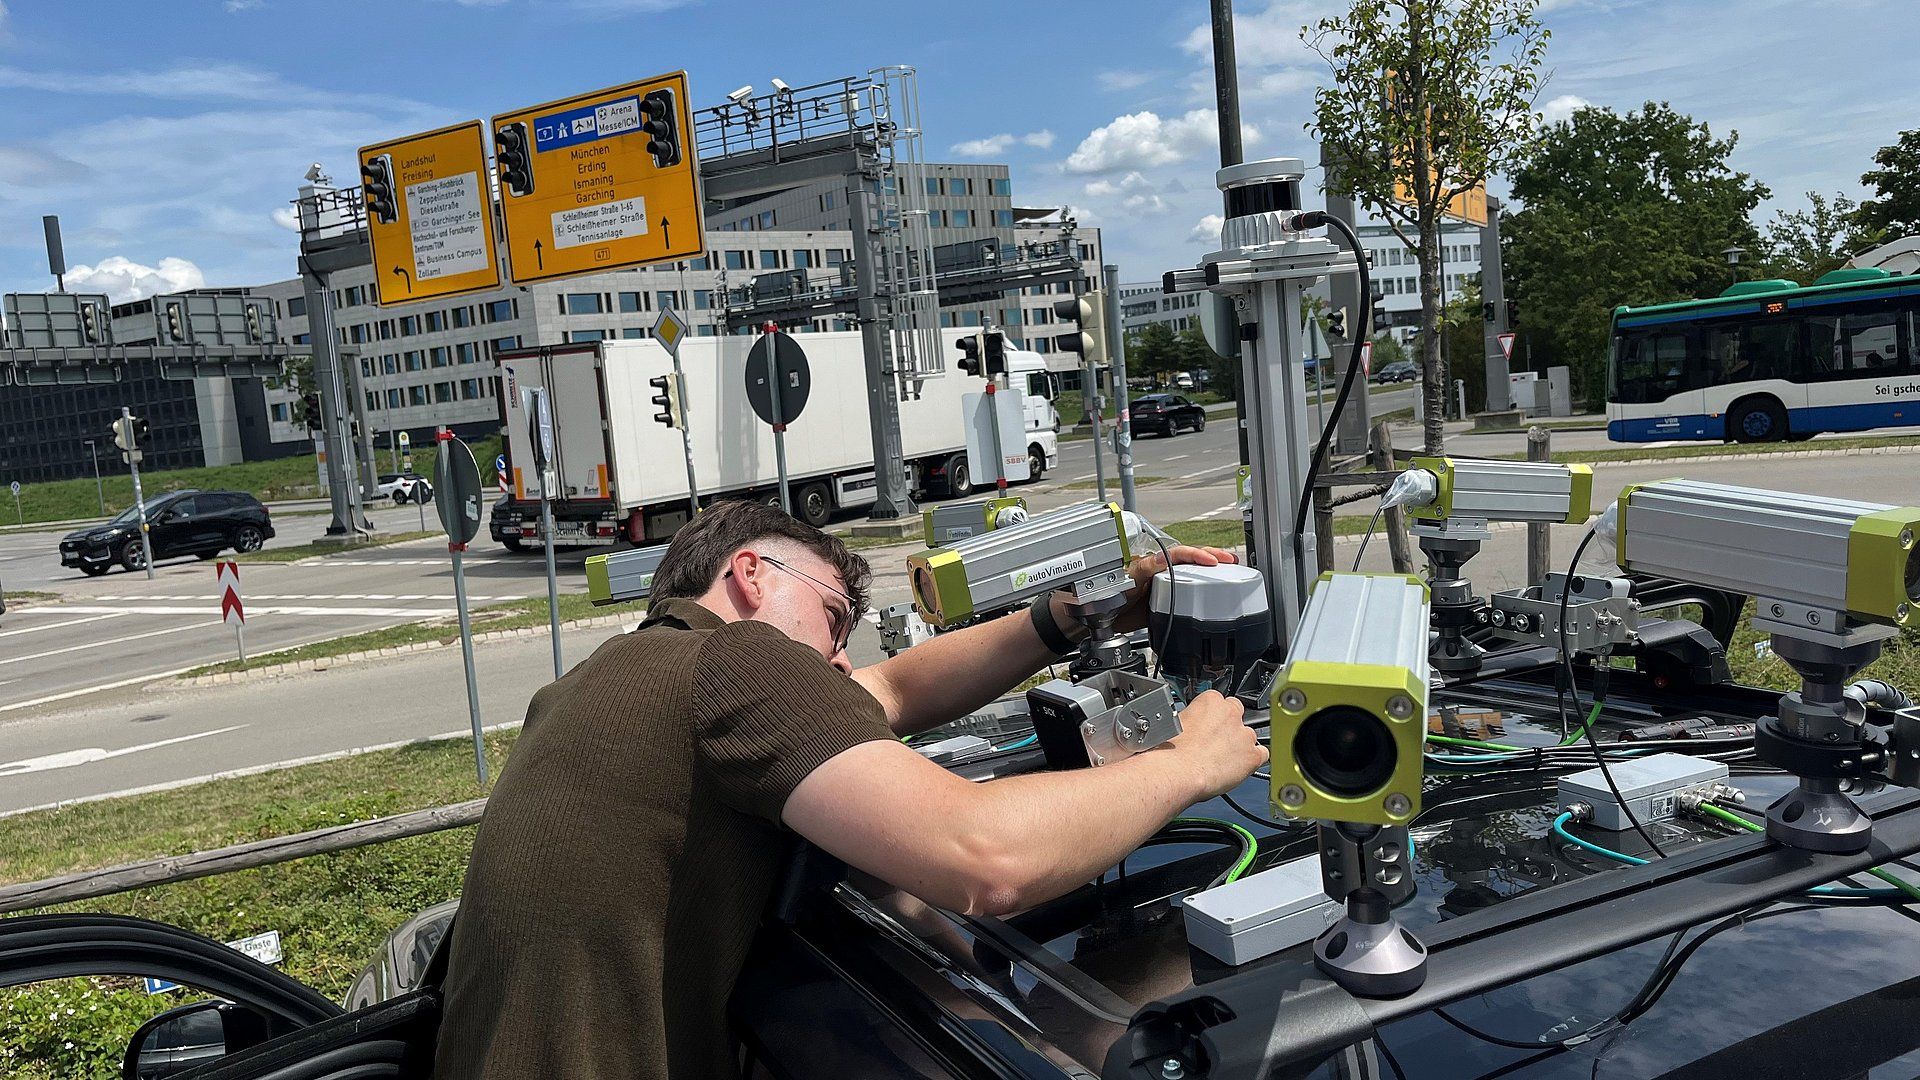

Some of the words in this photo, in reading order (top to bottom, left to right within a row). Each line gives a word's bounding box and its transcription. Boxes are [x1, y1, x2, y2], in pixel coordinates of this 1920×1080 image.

[610, 105, 632, 116] Arena
[587, 120, 593, 128] M
[599, 117, 638, 132] Messe/ICM
[571, 144, 610, 161] München
[401, 154, 436, 170] Landshut
[578, 161, 607, 174] Erding
[402, 168, 434, 182] Freising
[574, 174, 614, 190] Ismaning
[576, 188, 615, 204] Garching
[420, 201, 459, 215] Dieselstraße
[432, 213, 465, 228] Garchinger
[468, 210, 480, 220] See
[567, 218, 616, 234] Schleißheimer
[620, 212, 644, 224] Straße
[578, 228, 623, 244] Tennisanlage
[426, 252, 455, 264] Business
[456, 248, 483, 260] Campus
[1876, 384, 1890, 395] Sei
[1028, 558, 1083, 583] autoVimation
